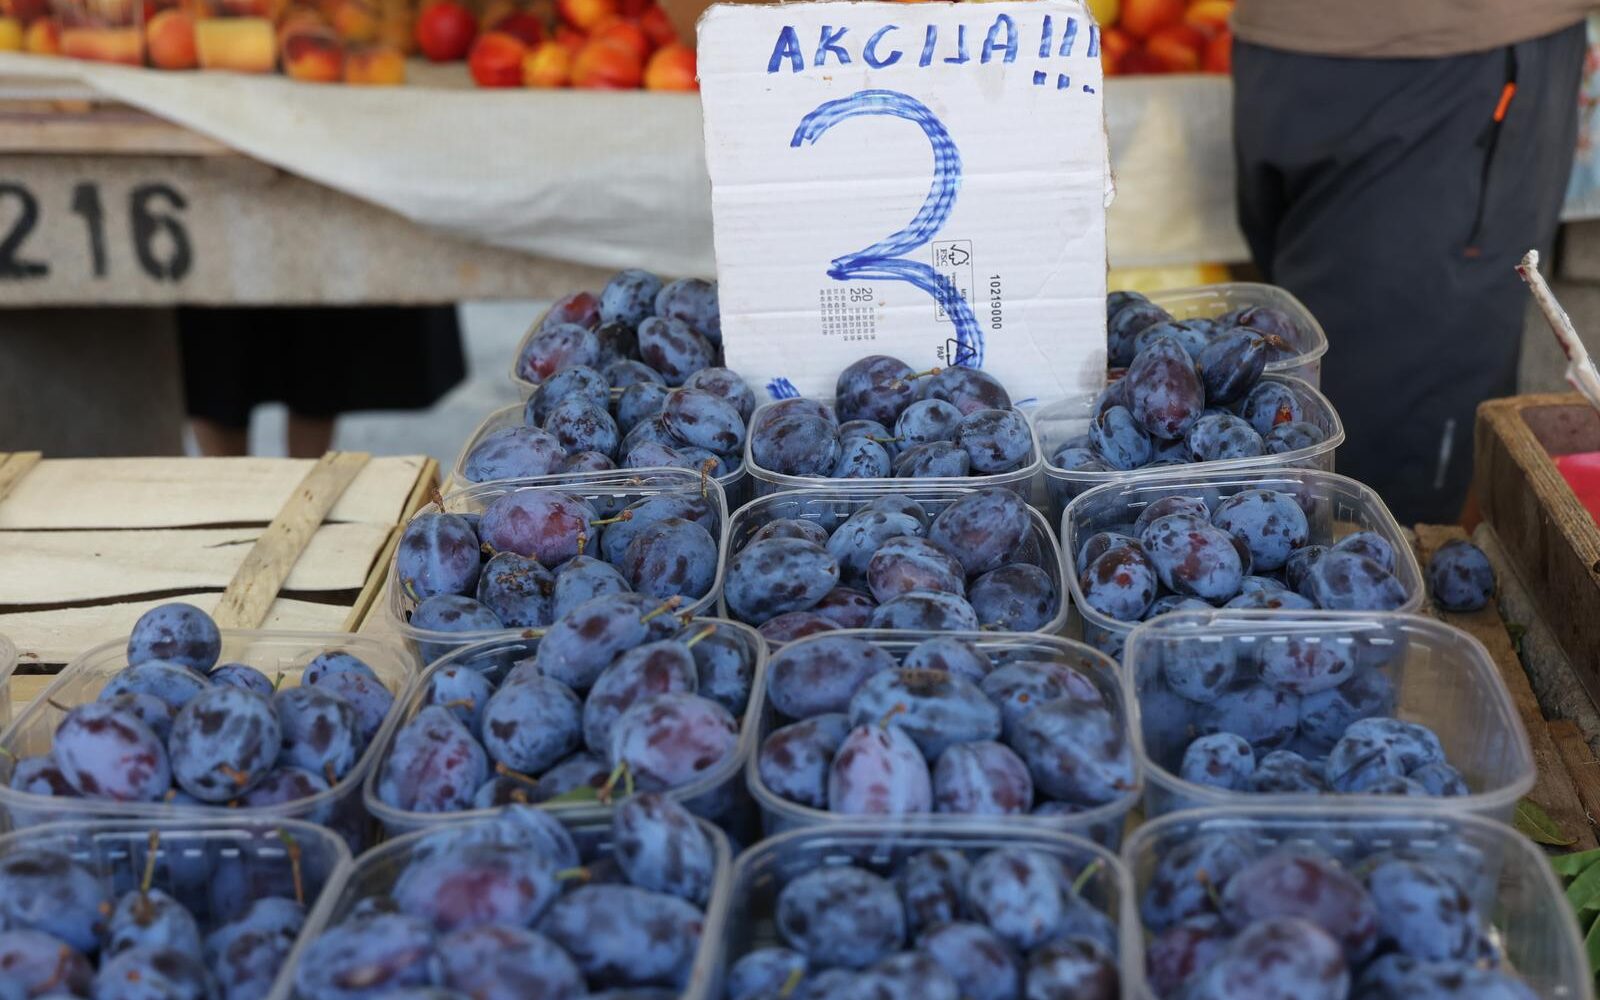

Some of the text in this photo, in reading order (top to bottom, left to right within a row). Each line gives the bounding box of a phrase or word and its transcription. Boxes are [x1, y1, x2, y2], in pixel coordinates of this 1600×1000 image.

[0, 181, 193, 283] 216
[940, 248, 949, 267] FSC
[990, 274, 1002, 330] 10219000
[936, 345, 945, 361] PAP
